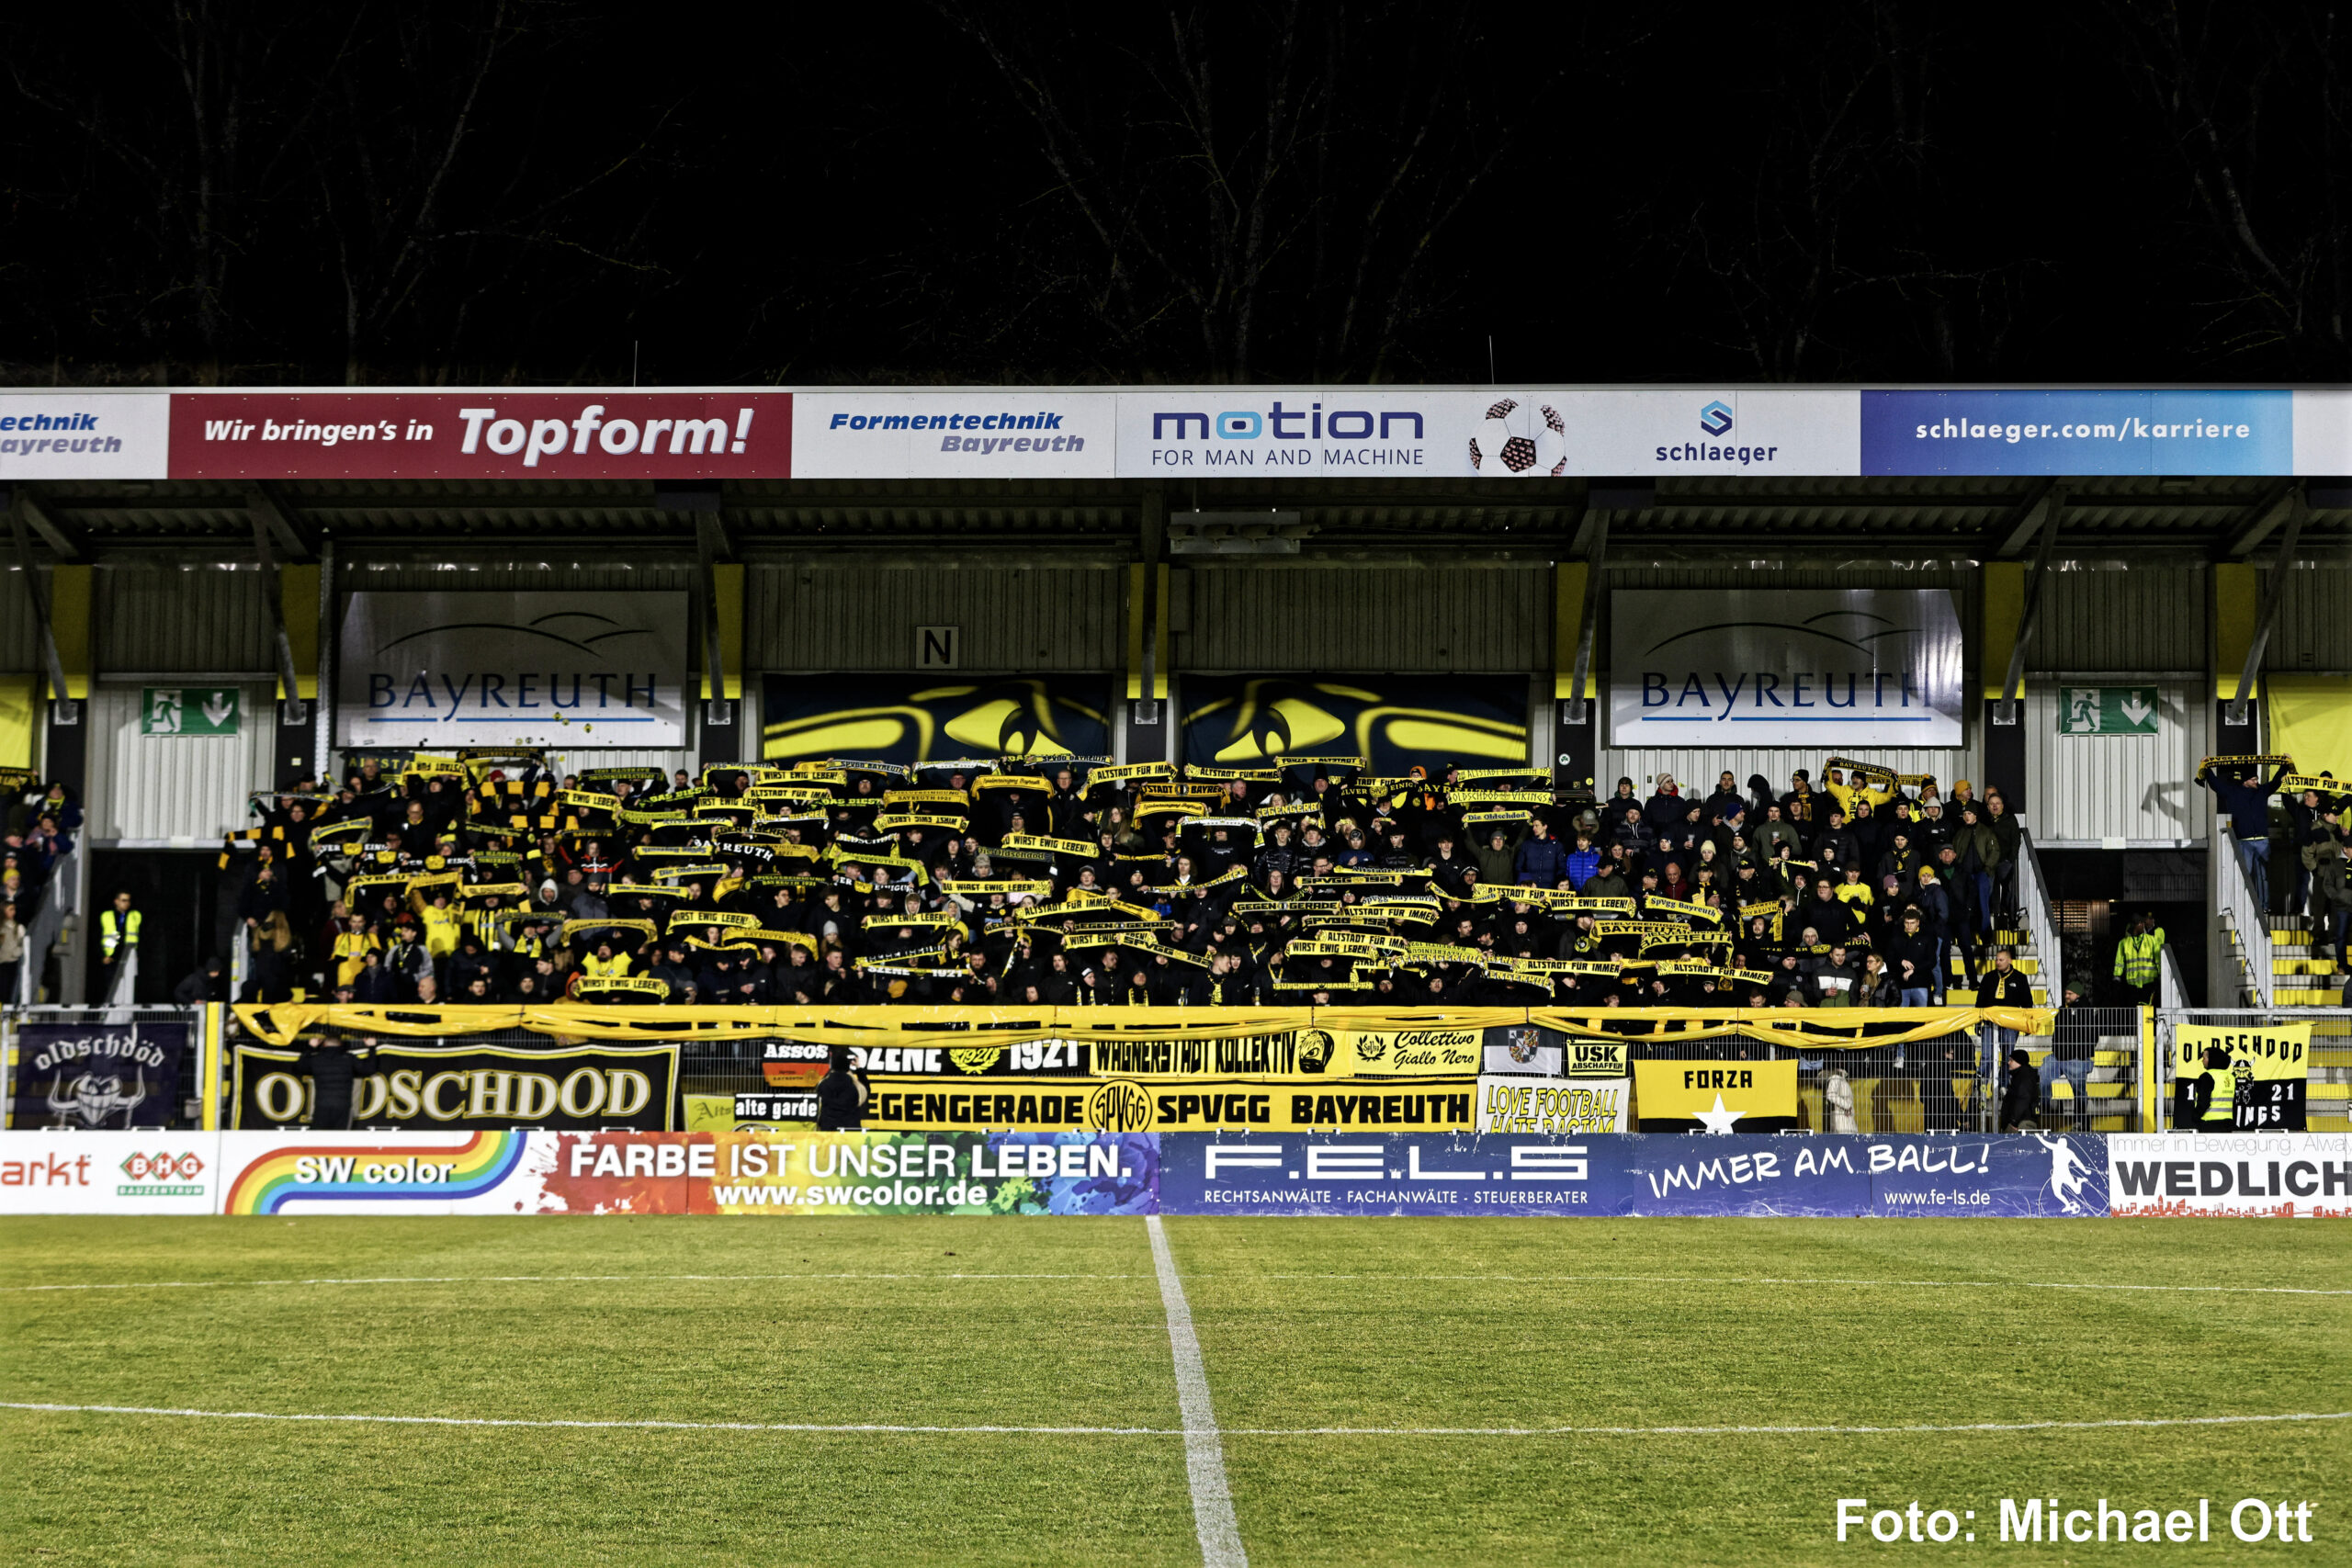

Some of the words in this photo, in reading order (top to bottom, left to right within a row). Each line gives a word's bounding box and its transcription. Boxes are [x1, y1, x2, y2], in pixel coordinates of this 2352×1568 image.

[830, 412, 1064, 431] Formentechnik
[1153, 401, 1424, 440] motion
[205, 419, 255, 441] Wir
[262, 418, 397, 446] bringen's
[404, 419, 435, 441] in
[458, 404, 754, 468] Topform!
[1916, 417, 2250, 444] schlaeger.com/karriere
[940, 434, 1085, 456] Bayreuth
[1655, 442, 1778, 466] schlaeger
[1152, 449, 1193, 466] FOR
[1205, 449, 1254, 466] MAN
[1264, 449, 1312, 465] AND
[1323, 448, 1424, 465] MACHINE
[923, 629, 952, 664] N
[368, 672, 656, 723] BAYREUTH
[1642, 671, 1933, 722] BAYREUTH
[764, 771, 786, 781] WIRST
[790, 771, 809, 780] EWIG
[812, 771, 838, 780] LEBEN!
[1097, 767, 1133, 781] ALTSTADT
[1136, 765, 1151, 775] FÜR
[1200, 767, 1236, 777] ALTSTADT
[1839, 761, 1878, 773] BAYREUTH
[1512, 792, 1547, 801] VIKINGS
[1468, 814, 1481, 822] Die
[1484, 812, 1526, 820] Oldschdod
[1013, 835, 1037, 846] WIRST
[1039, 839, 1058, 849] EWIG
[1062, 841, 1088, 853] LEBEN!
[943, 883, 953, 892] DU
[956, 883, 980, 892] WIRST
[984, 882, 1004, 892] EWIG
[1008, 881, 1035, 892] LEBEN!
[1024, 902, 1063, 917] ALTSTADT
[1067, 899, 1083, 910] FÜR
[1237, 902, 1282, 911] GEGEN
[1290, 901, 1338, 909] GERADE
[1344, 906, 1384, 917] ALTSTADT
[1388, 908, 1405, 917] FÜR
[1550, 898, 1574, 908] WIRST
[1578, 898, 1598, 908] EWIG
[1601, 898, 1628, 908] LEBEN!
[1650, 897, 1677, 909] SpVgg
[1679, 901, 1716, 918] Bayreuth
[698, 912, 718, 921] EWIG
[721, 913, 749, 925] LEBEN!
[869, 914, 893, 924] WIRST
[898, 914, 917, 922] EWIG
[921, 912, 947, 922] LEBEN!
[1069, 935, 1092, 946] WIRST
[1123, 937, 1174, 955] SPVGG
[1328, 931, 1365, 943] ALTSTADT
[1369, 935, 1385, 945] FÜR
[1293, 942, 1316, 952] WIRST
[1319, 943, 1340, 953] EWIG
[1343, 944, 1371, 955] LEBEN!
[1528, 961, 1567, 970] ALTSTADT
[1571, 962, 1589, 971] FÜR
[1592, 964, 1620, 974] IMMER
[1674, 964, 1715, 975] ALTSTADT
[1718, 966, 1736, 976] FÜR
[610, 979, 629, 987] EWIG
[1393, 1031, 1476, 1049] Collettivo
[847, 1046, 942, 1073] SZENE
[1009, 1039, 1079, 1071] 1921
[1393, 1050, 1437, 1070] Giallo
[1444, 1049, 1475, 1065] Nero
[1575, 1045, 1620, 1063] USK
[1572, 1061, 1623, 1071] ABSCHAFFEN
[1684, 1068, 1753, 1089] FORZA
[255, 1066, 651, 1122] ODSCHDOD
[1486, 1084, 1531, 1116] LOVE
[1535, 1087, 1619, 1118] FOOTBALL
[736, 1098, 767, 1116] alte
[772, 1098, 818, 1121] garde
[1157, 1093, 1271, 1124] SPVGG
[1291, 1093, 1470, 1124] BAYREUTH
[2113, 1135, 2166, 1152] Immer
[2174, 1135, 2188, 1152] in
[0, 1151, 91, 1187] arkt
[132, 1157, 198, 1176] BHG
[571, 1144, 717, 1178] FARBE
[729, 1144, 796, 1178] IST
[808, 1144, 956, 1178] UNSER
[971, 1144, 1133, 1178] LEBEN.
[294, 1156, 357, 1185] SW
[363, 1156, 457, 1186] color
[1648, 1150, 1781, 1199] IMMER
[1793, 1145, 1854, 1178] AM
[1868, 1142, 1991, 1174] BALL!
[2114, 1160, 2352, 1197] WEDLICH
[119, 1186, 203, 1195] BAUZENTRUM
[713, 1179, 989, 1206] www.swcolor.de
[1204, 1188, 1332, 1204] RECHTSANWÄLTE
[1347, 1188, 1458, 1204] FACHANWÄLTE
[1474, 1189, 1589, 1203] STEUERBERATER
[1883, 1188, 1992, 1205] www.fe-ls.de
